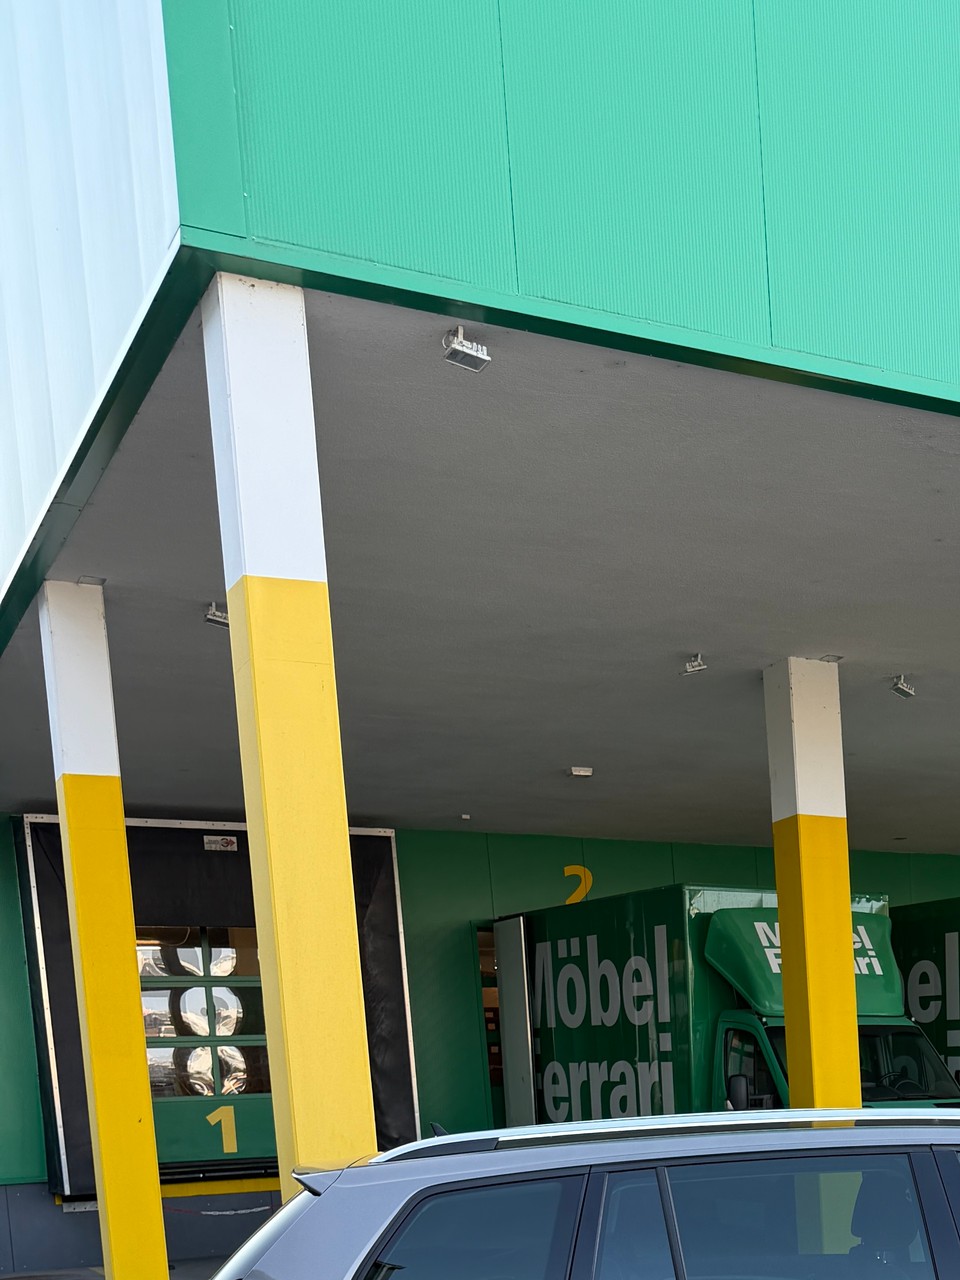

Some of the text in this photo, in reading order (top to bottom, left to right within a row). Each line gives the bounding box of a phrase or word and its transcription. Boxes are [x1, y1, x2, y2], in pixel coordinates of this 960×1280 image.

[563, 865, 593, 905] 2
[534, 1032, 675, 1123] errari
[206, 1105, 238, 1153] 1
